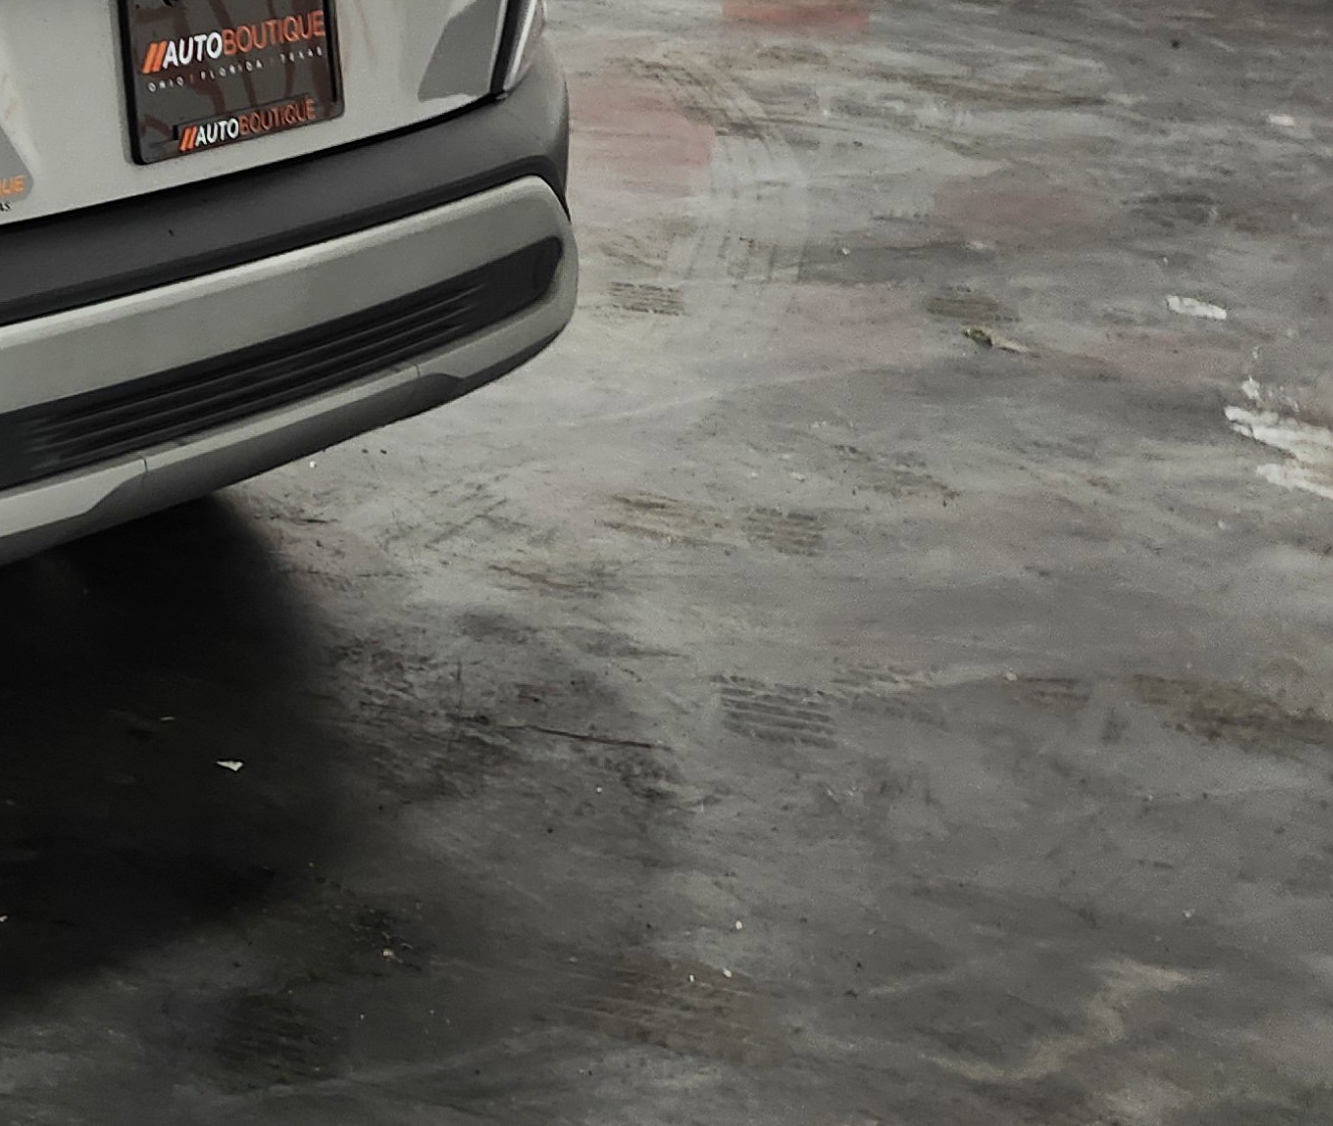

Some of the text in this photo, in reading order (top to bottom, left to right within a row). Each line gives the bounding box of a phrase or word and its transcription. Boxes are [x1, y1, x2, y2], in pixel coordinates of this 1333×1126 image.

[162, 9, 326, 70] AUTOBOUTIQUE
[200, 59, 264, 80] FLORIDA
[195, 97, 317, 147] AUTOBOUTIQUE
